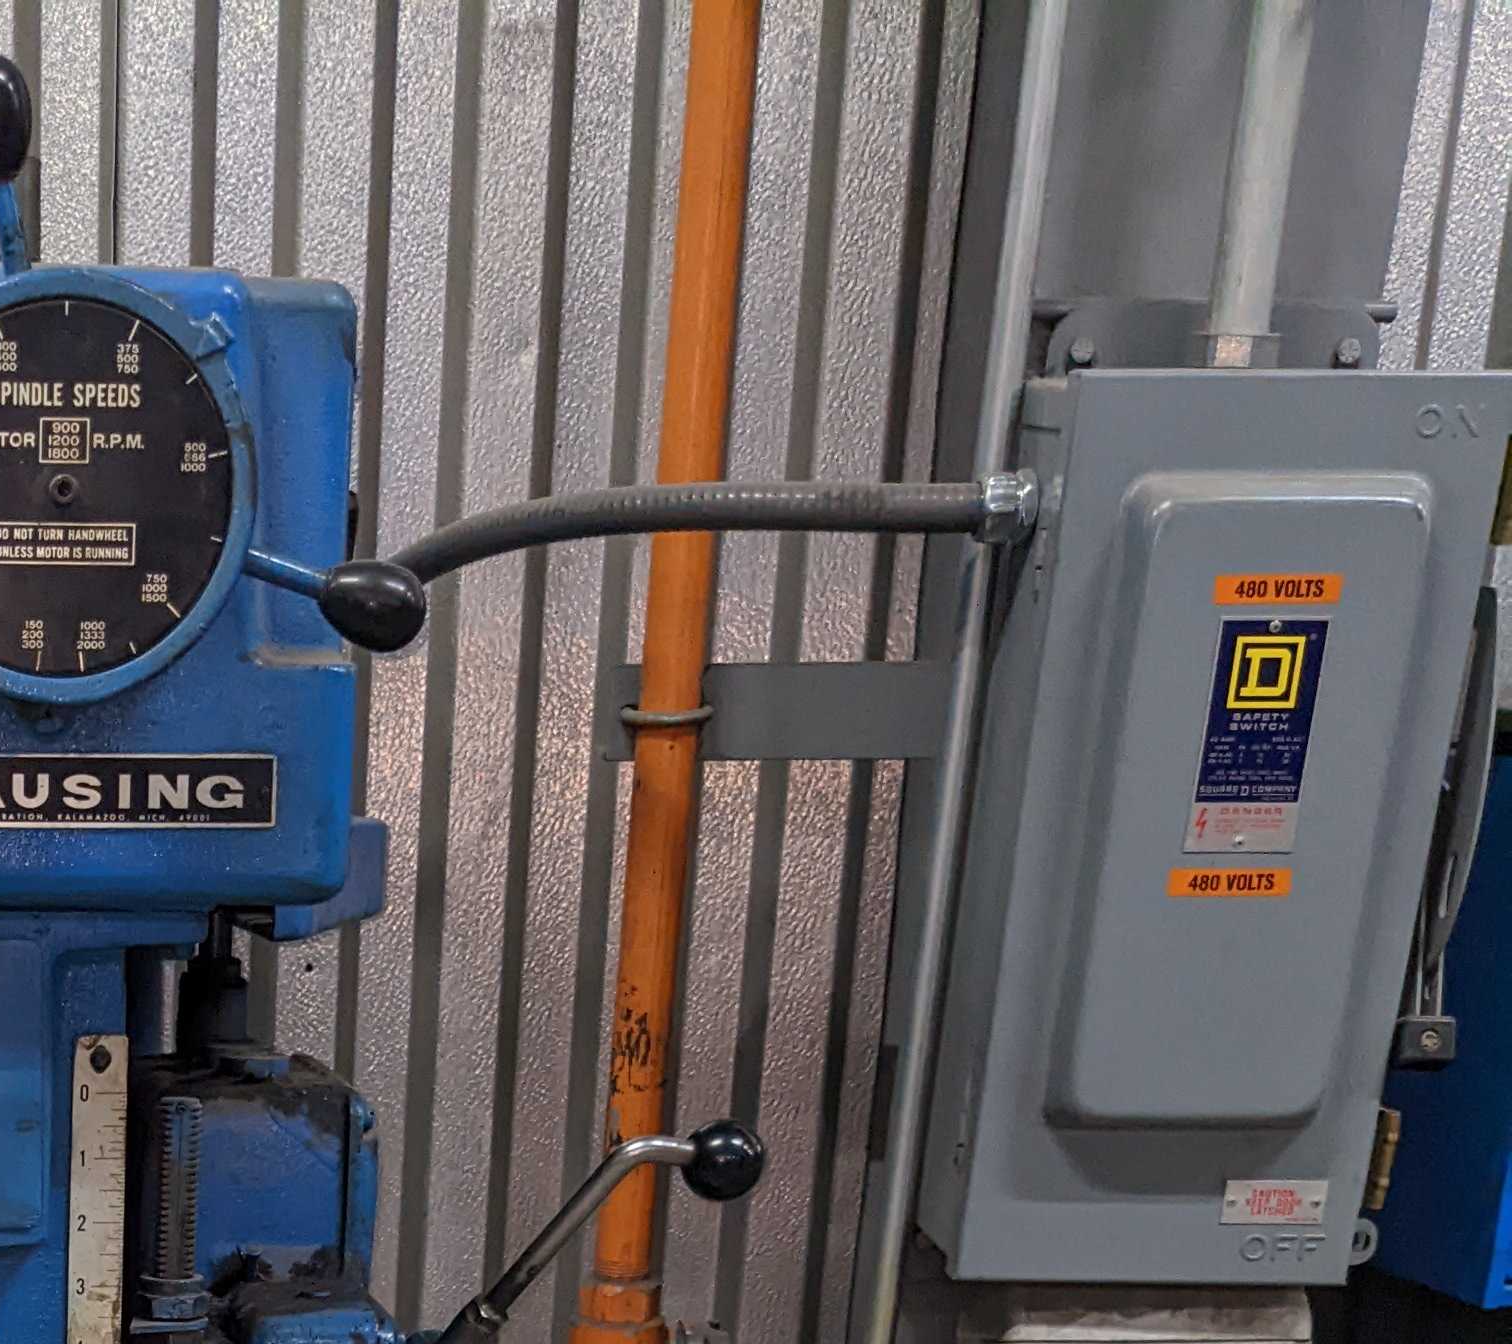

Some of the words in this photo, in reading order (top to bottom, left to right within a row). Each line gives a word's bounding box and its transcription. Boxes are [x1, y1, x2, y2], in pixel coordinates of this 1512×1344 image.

[117, 344, 139, 354] 375
[116, 354, 139, 364] 500
[116, 364, 139, 374] 750
[73, 383, 141, 407] SPEEDS
[51, 422, 80, 434] 900
[48, 435, 80, 447] 1200
[92, 434, 145, 449] R.P.M.
[48, 448, 80, 459] 1800
[180, 462, 207, 472] 1000
[13, 529, 33, 541] NOT
[38, 529, 64, 541] TURN
[68, 529, 129, 542] HANDWHEEL
[36, 547, 70, 559] MOTOR
[72, 547, 82, 559] IS
[85, 547, 129, 560] RUNNING
[146, 574, 167, 584] 750
[142, 583, 167, 593] 1000
[1234, 579, 1269, 599] 480
[1273, 579, 1326, 599] VOLTS
[141, 593, 168, 603] 1500
[24, 620, 44, 630] 150
[80, 620, 105, 630] 1000
[22, 630, 44, 639] 200
[79, 630, 105, 640] 1333
[21, 639, 44, 649] 300
[77, 639, 105, 650] 2000
[1239, 647, 1294, 697] D
[1231, 713, 1290, 721] SAFETY
[1229, 723, 1289, 731] SWITCH
[1240, 785, 1249, 796] D
[1252, 785, 1297, 793] COMPANY
[1187, 873, 1221, 892] 480
[1226, 872, 1276, 892] VOLTS
[79, 1085, 89, 1102] 0
[79, 1151, 86, 1167] 1
[77, 1215, 86, 1232] 2
[1240, 1233, 1328, 1263] OFF
[76, 1278, 85, 1295] 3
